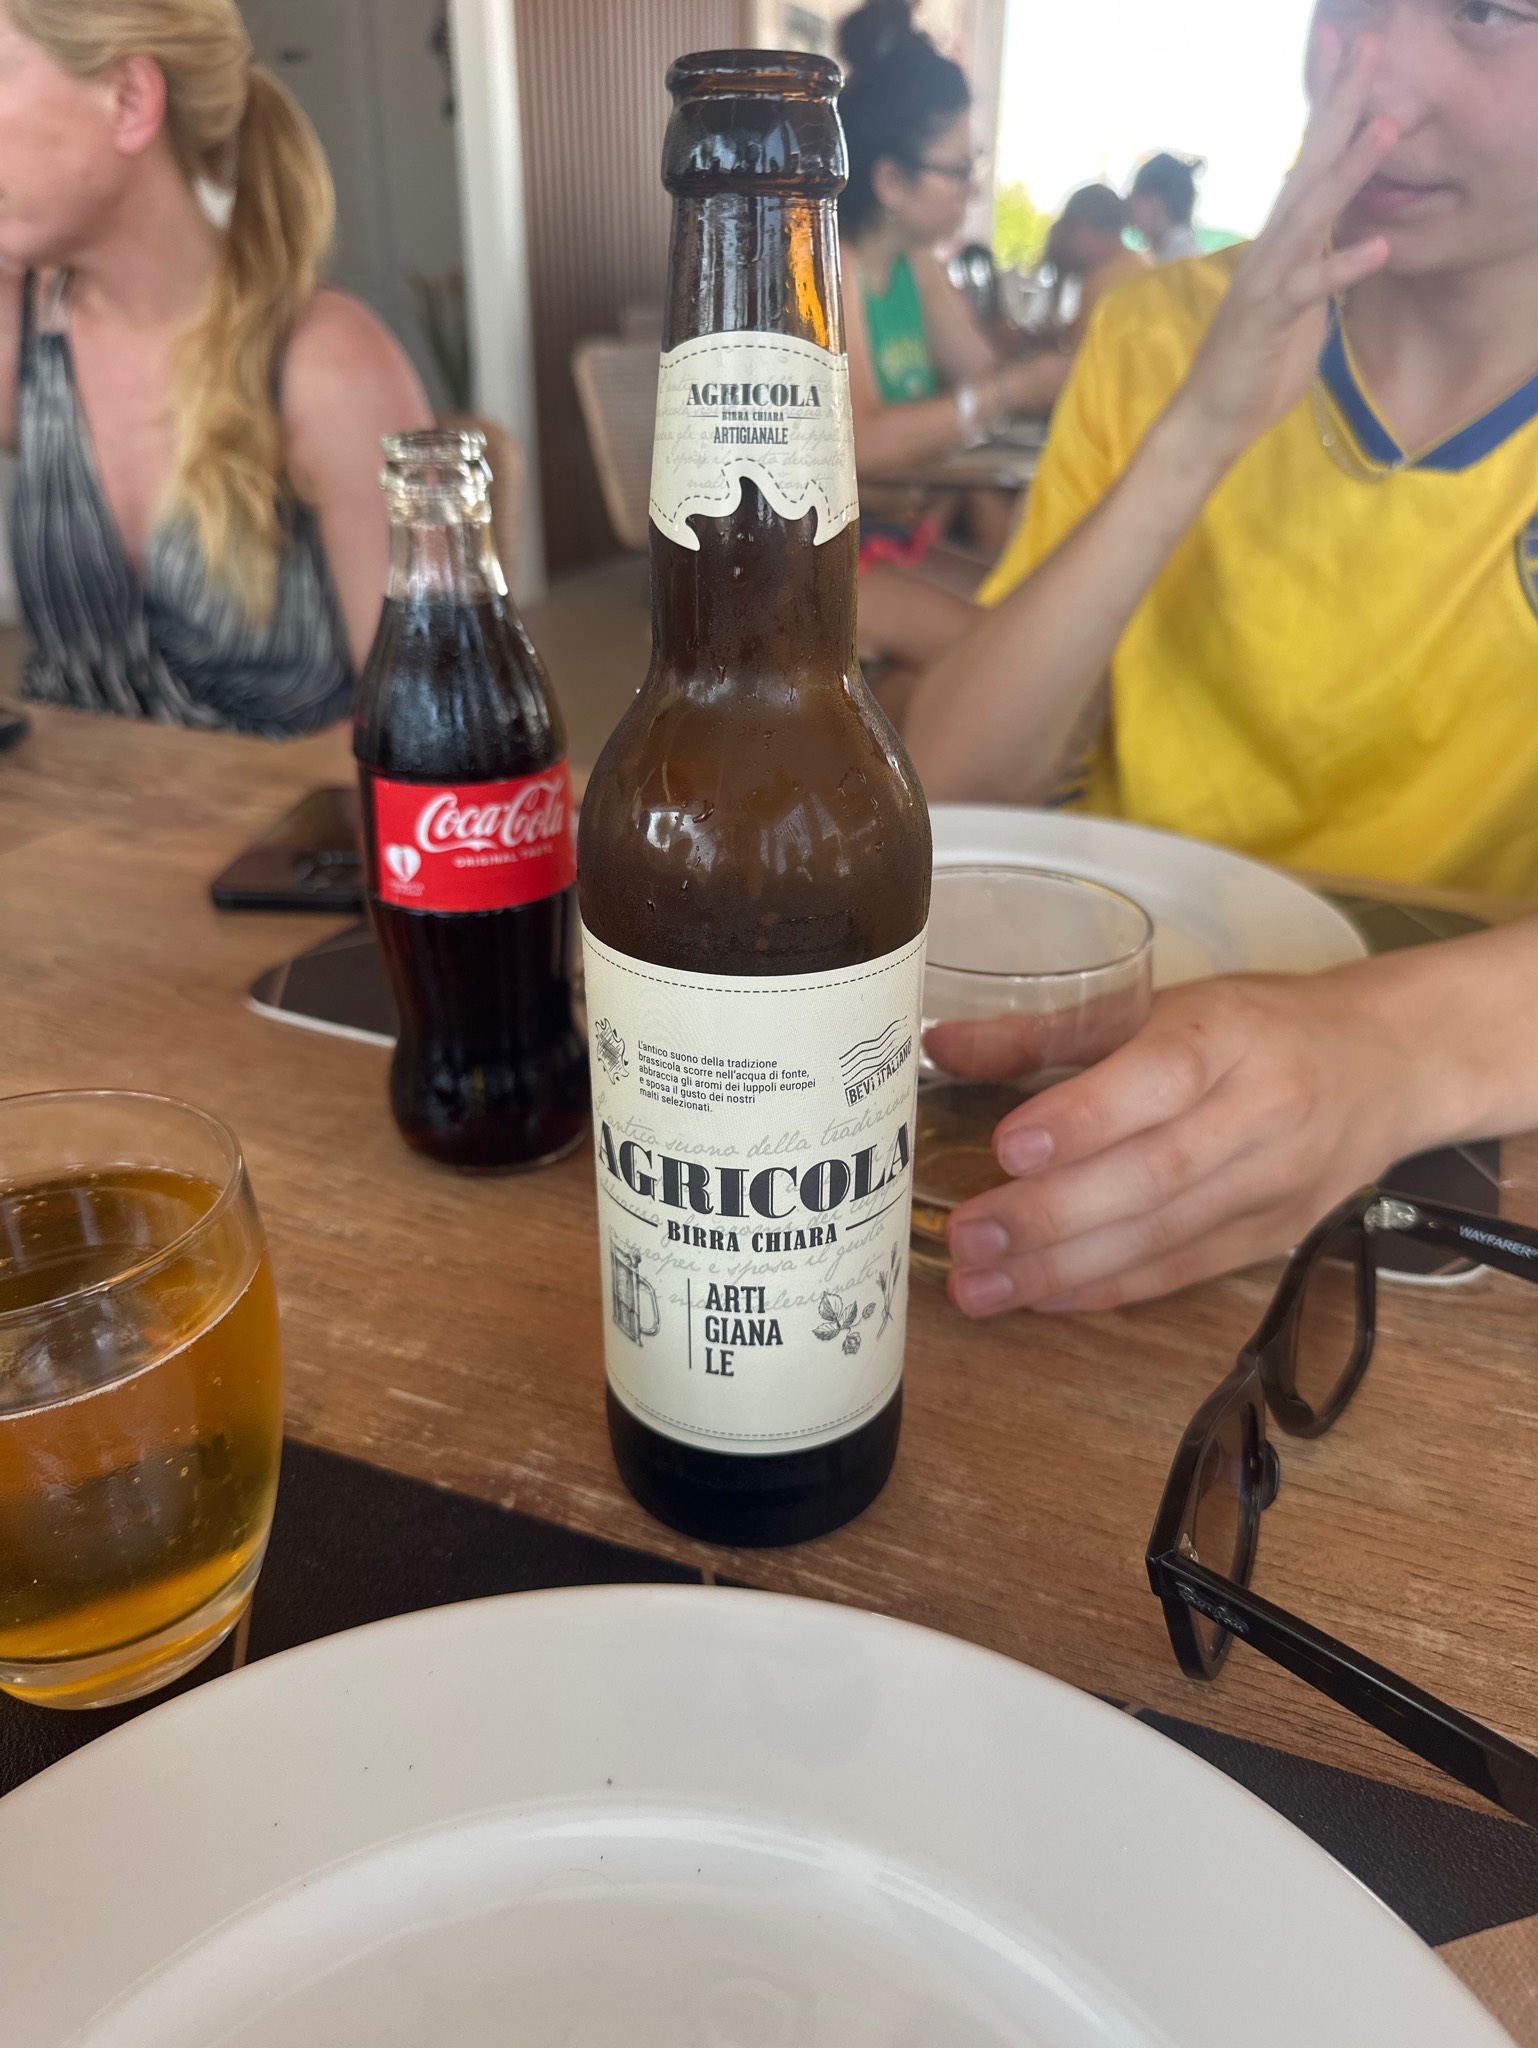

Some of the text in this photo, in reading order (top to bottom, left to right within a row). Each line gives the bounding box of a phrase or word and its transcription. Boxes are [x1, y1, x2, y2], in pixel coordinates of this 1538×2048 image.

[687, 383, 821, 408] AGRICOLA
[722, 411, 749, 421] BIRRA
[752, 411, 784, 421] CHIARA
[713, 426, 788, 445] ARTIGIANALE
[416, 779, 565, 853] Coca-Cola
[638, 1039, 778, 1069] L'antico suono della tradizione
[638, 1051, 810, 1082] brassicola scorre nell'acqua di fonte,
[639, 1064, 816, 1094] abbraccia gli aromi dei luppoli europei
[639, 1076, 756, 1104] e sposa il gusto dei nostri
[640, 1086, 713, 1113] malti selezionati.
[599, 1120, 910, 1219] AGRICOLA
[667, 1219, 740, 1252] BIRRA
[751, 1222, 838, 1253] CHIARA
[705, 1282, 766, 1314] ARTI
[705, 1315, 784, 1346] GIANA
[705, 1346, 734, 1377] LE
